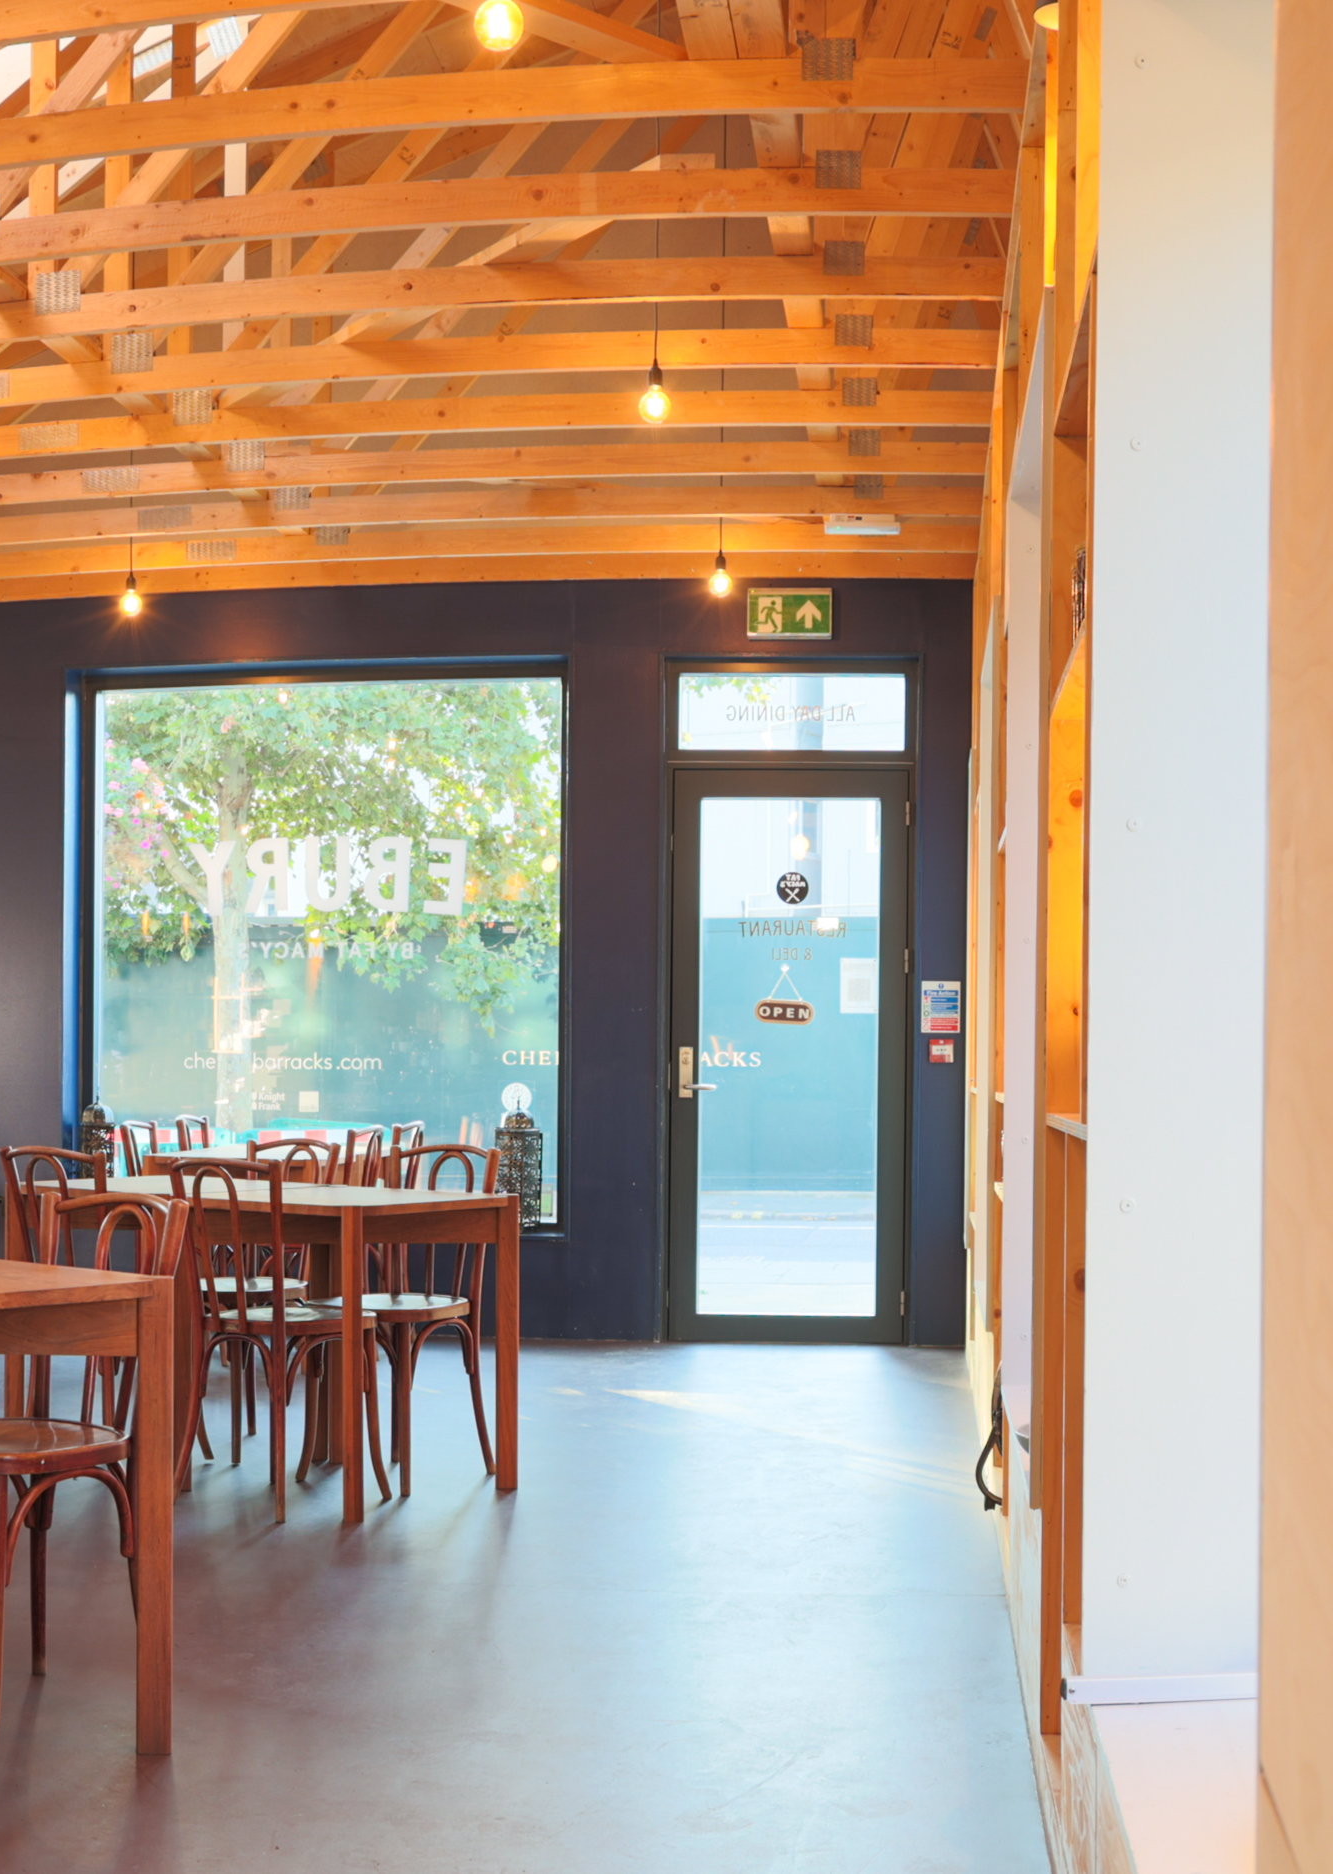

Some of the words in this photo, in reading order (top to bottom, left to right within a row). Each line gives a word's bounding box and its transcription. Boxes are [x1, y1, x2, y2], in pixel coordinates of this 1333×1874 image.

[758, 1005, 810, 1019] OPEN
[700, 1051, 762, 1067] ACKS
[258, 1091, 286, 1102] Knight
[258, 1102, 281, 1110] Frank
